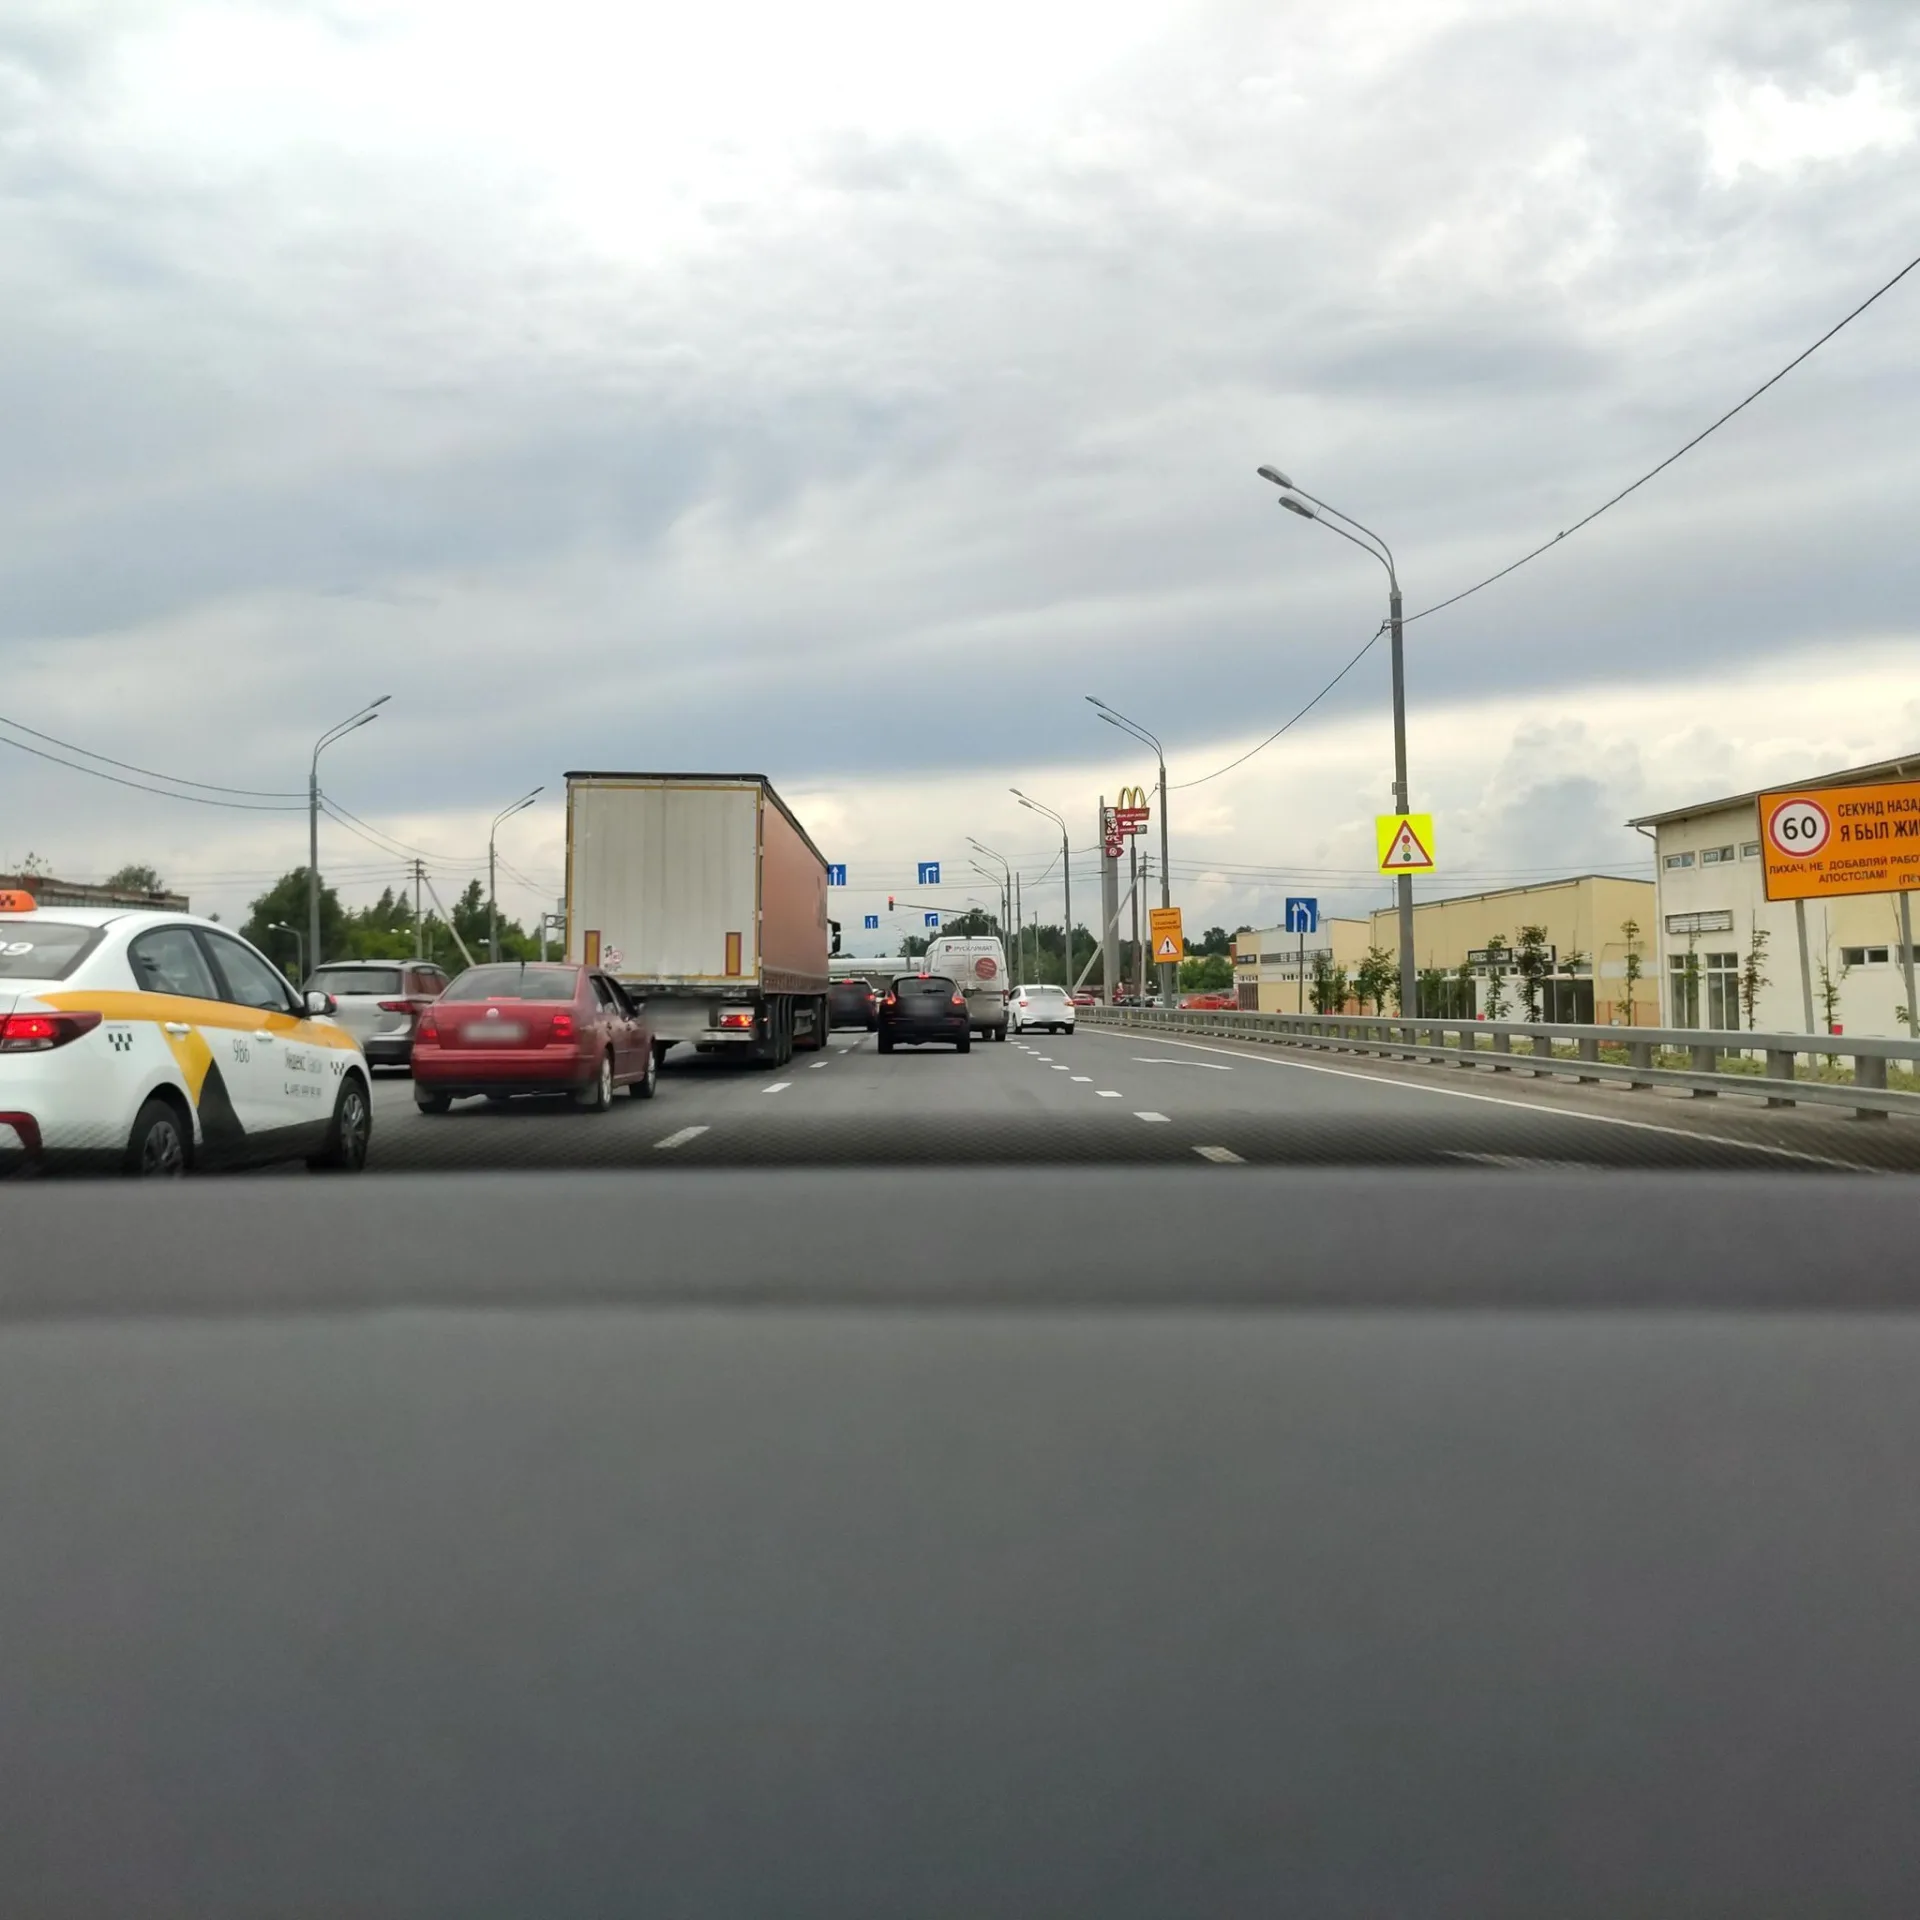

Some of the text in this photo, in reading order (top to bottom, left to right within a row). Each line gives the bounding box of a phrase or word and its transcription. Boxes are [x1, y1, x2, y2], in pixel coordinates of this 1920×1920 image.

[1838, 798, 1920, 818] СЕКУНД НАЗА
[1782, 816, 1817, 840] 60
[1840, 819, 1920, 842] Я БЫЛ ЖИ
[1809, 862, 1824, 872] НЕ
[1829, 856, 1888, 871] ДОБАВЛЯЙ
[1818, 870, 1888, 884] АПОСТОЛАМ!
